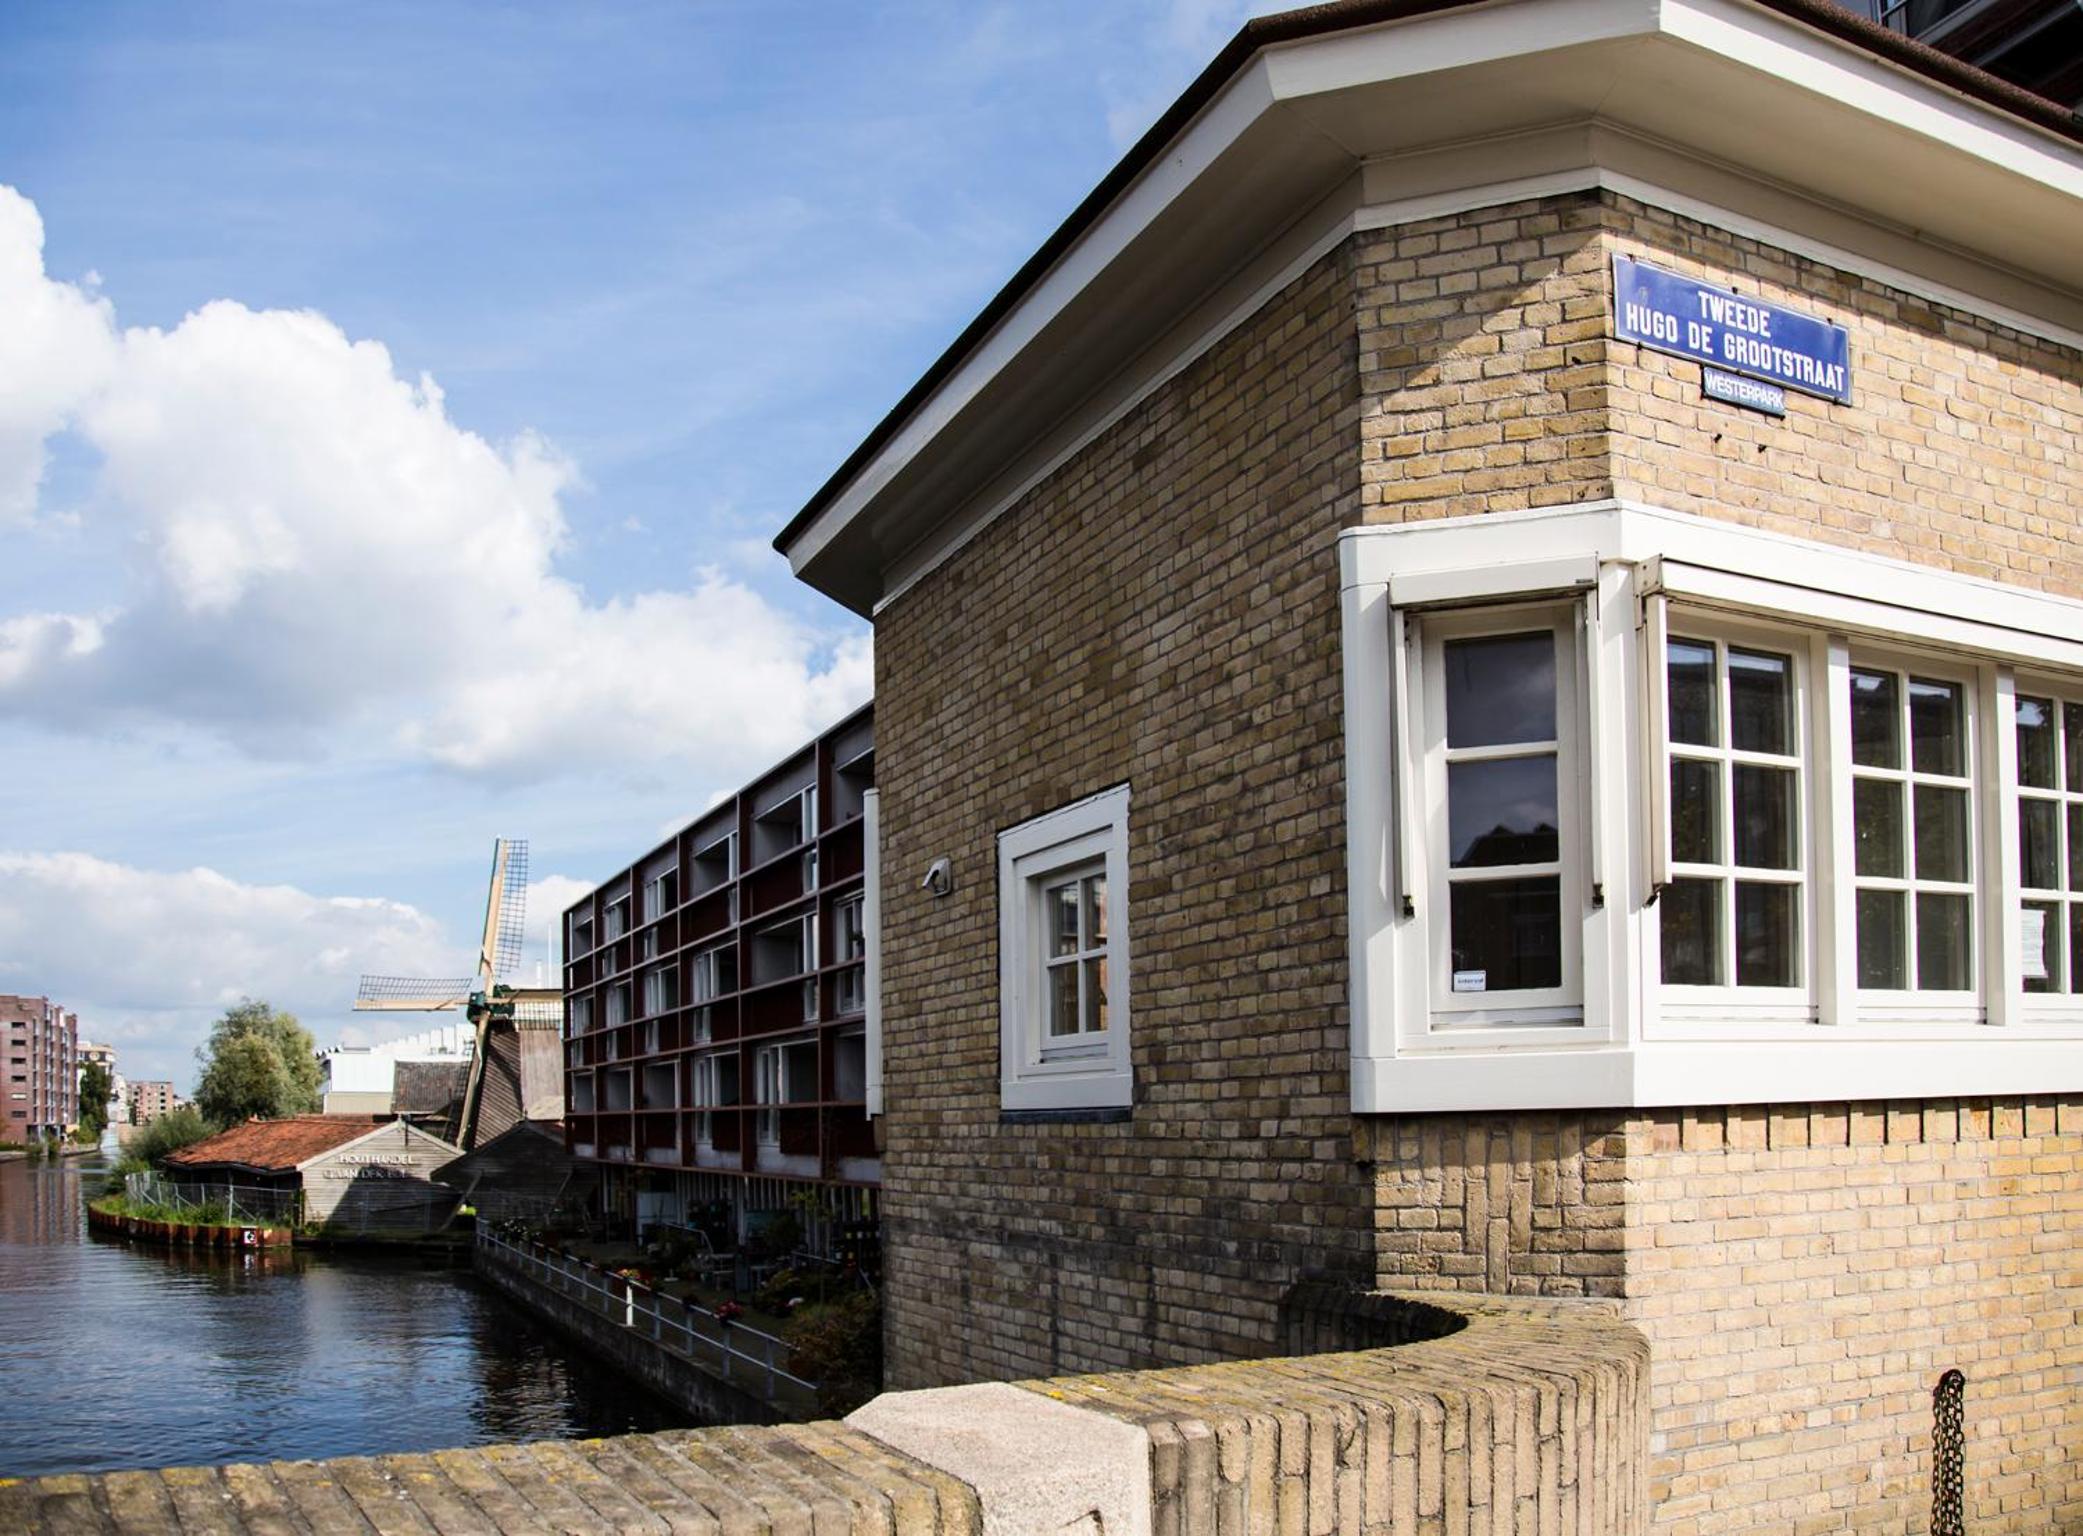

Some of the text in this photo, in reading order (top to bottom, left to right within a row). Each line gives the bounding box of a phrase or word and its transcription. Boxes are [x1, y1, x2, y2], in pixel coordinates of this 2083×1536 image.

[1698, 290, 1771, 338] TWEEDE
[1626, 302, 1845, 392] HUGO DE GROOTSTRAAT
[1704, 373, 1784, 409] WESTERPARK
[340, 1154, 414, 1164] HOUTHANDEL
